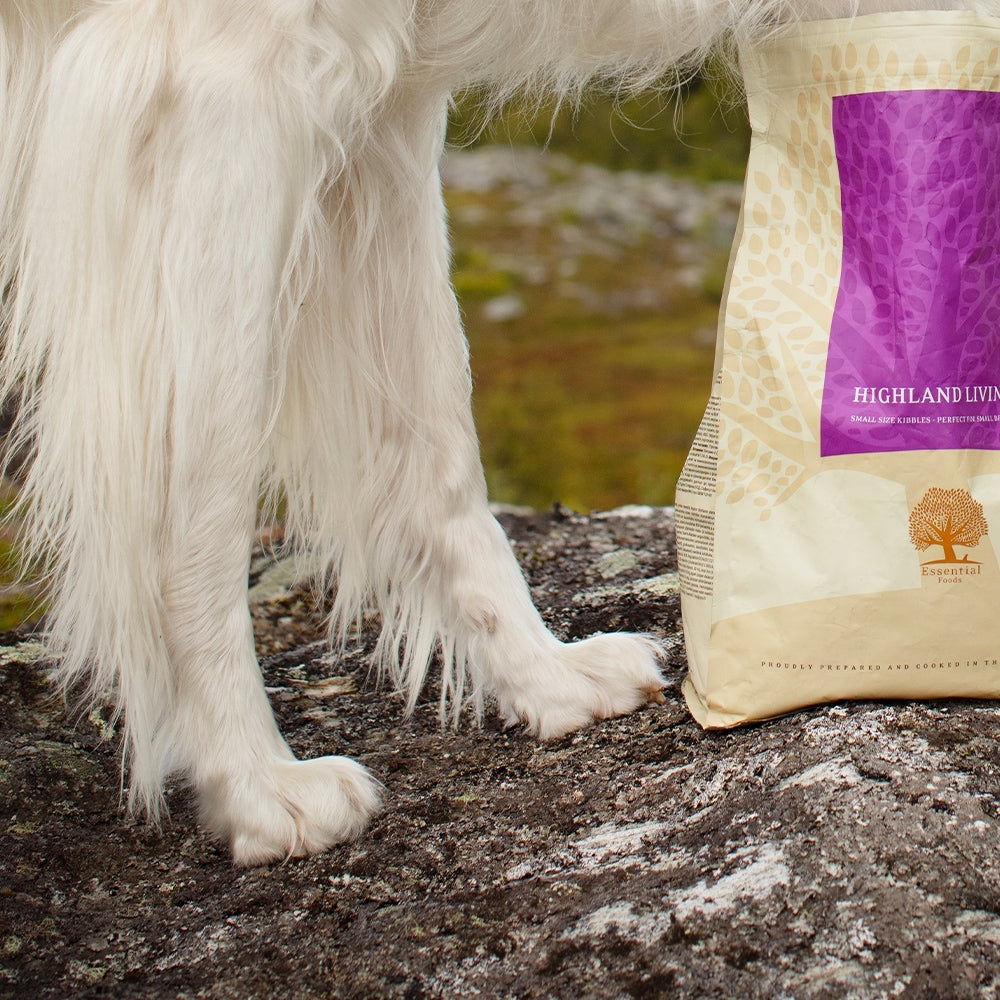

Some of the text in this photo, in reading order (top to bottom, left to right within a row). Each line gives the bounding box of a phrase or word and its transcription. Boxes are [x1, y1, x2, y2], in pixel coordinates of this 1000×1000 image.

[852, 386, 962, 404] HIGHLAND
[850, 414, 876, 423] SMALL
[878, 416, 895, 424] SIZE
[897, 416, 931, 424] KIBBLES
[937, 415, 966, 424] PERFECT
[976, 415, 994, 423] SMALL
[921, 565, 981, 576] Essential
[938, 576, 962, 584] Foods
[761, 661, 813, 670] PROUDLY
[915, 661, 960, 670] COOKED
